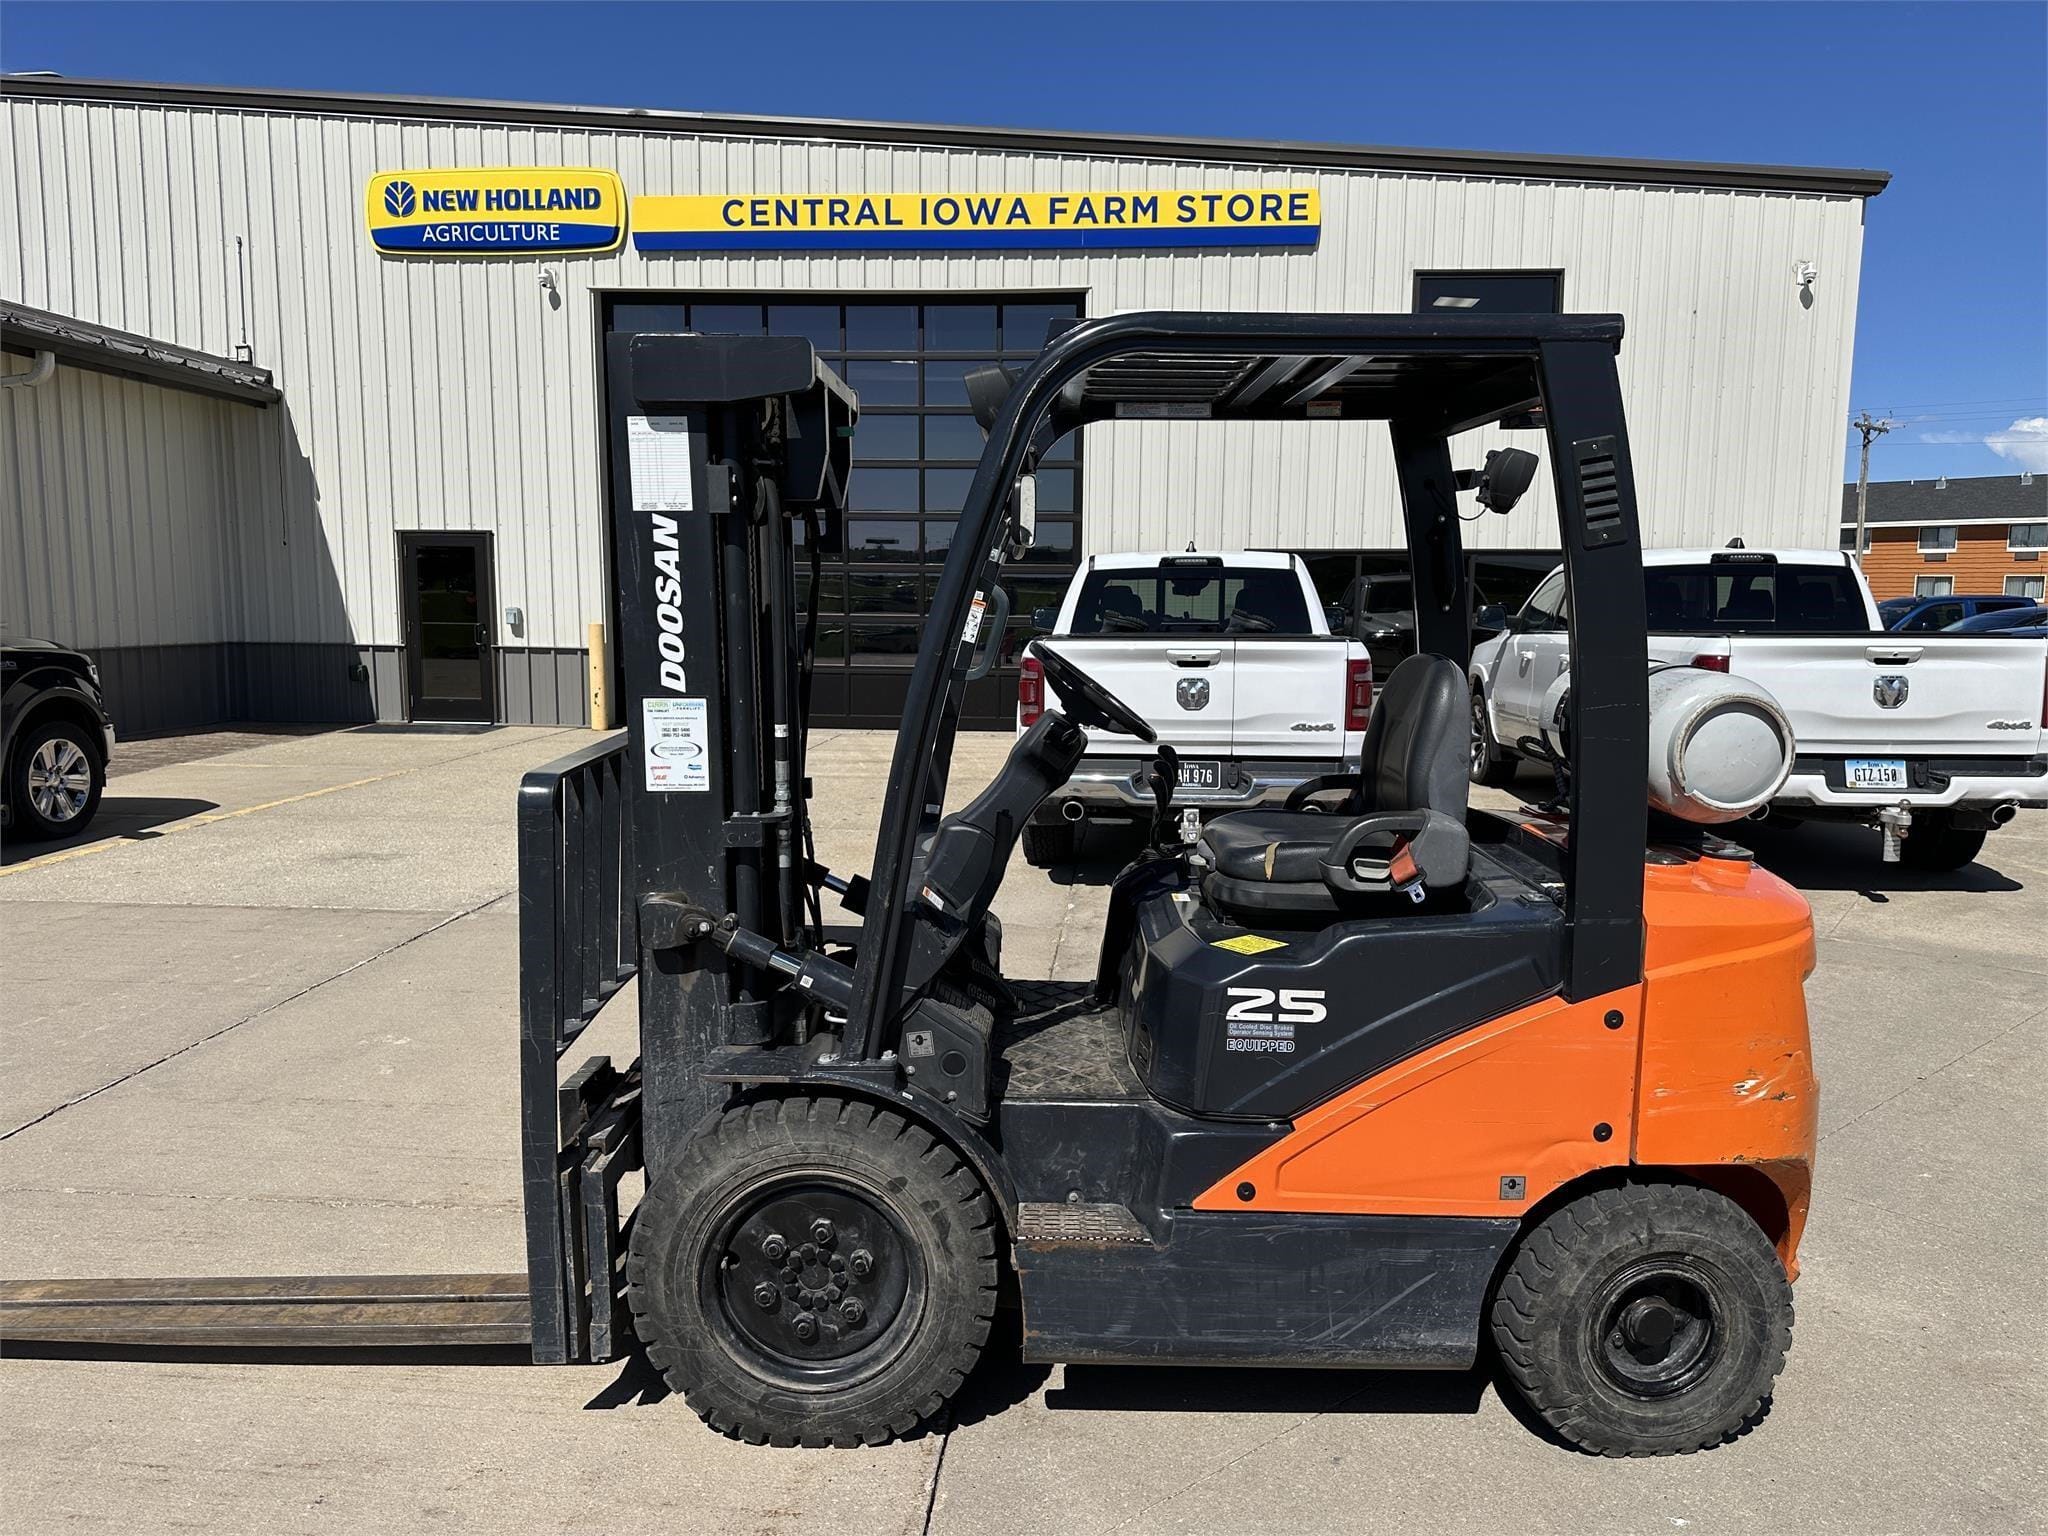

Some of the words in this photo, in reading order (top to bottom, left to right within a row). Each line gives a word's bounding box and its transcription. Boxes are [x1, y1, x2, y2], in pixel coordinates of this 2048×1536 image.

[422, 189, 479, 212] NEW
[484, 186, 601, 211] HOLLAND
[722, 198, 904, 227] CENTRAL
[920, 196, 1032, 226] IOWA
[1049, 195, 1159, 225] FARM
[1176, 193, 1310, 223] STORE
[422, 224, 561, 242] AGRICULTURE
[651, 513, 687, 693] DOOSAN
[1290, 722, 1336, 732] 4x4
[1986, 721, 2033, 730] 4x4
[1177, 769, 1190, 783] AH
[1193, 769, 1213, 783] 976
[1854, 768, 1873, 781] GTZ
[1877, 768, 1897, 782] 150
[1226, 987, 1327, 1023] 25
[1226, 1039, 1295, 1053] EQUIPPED
